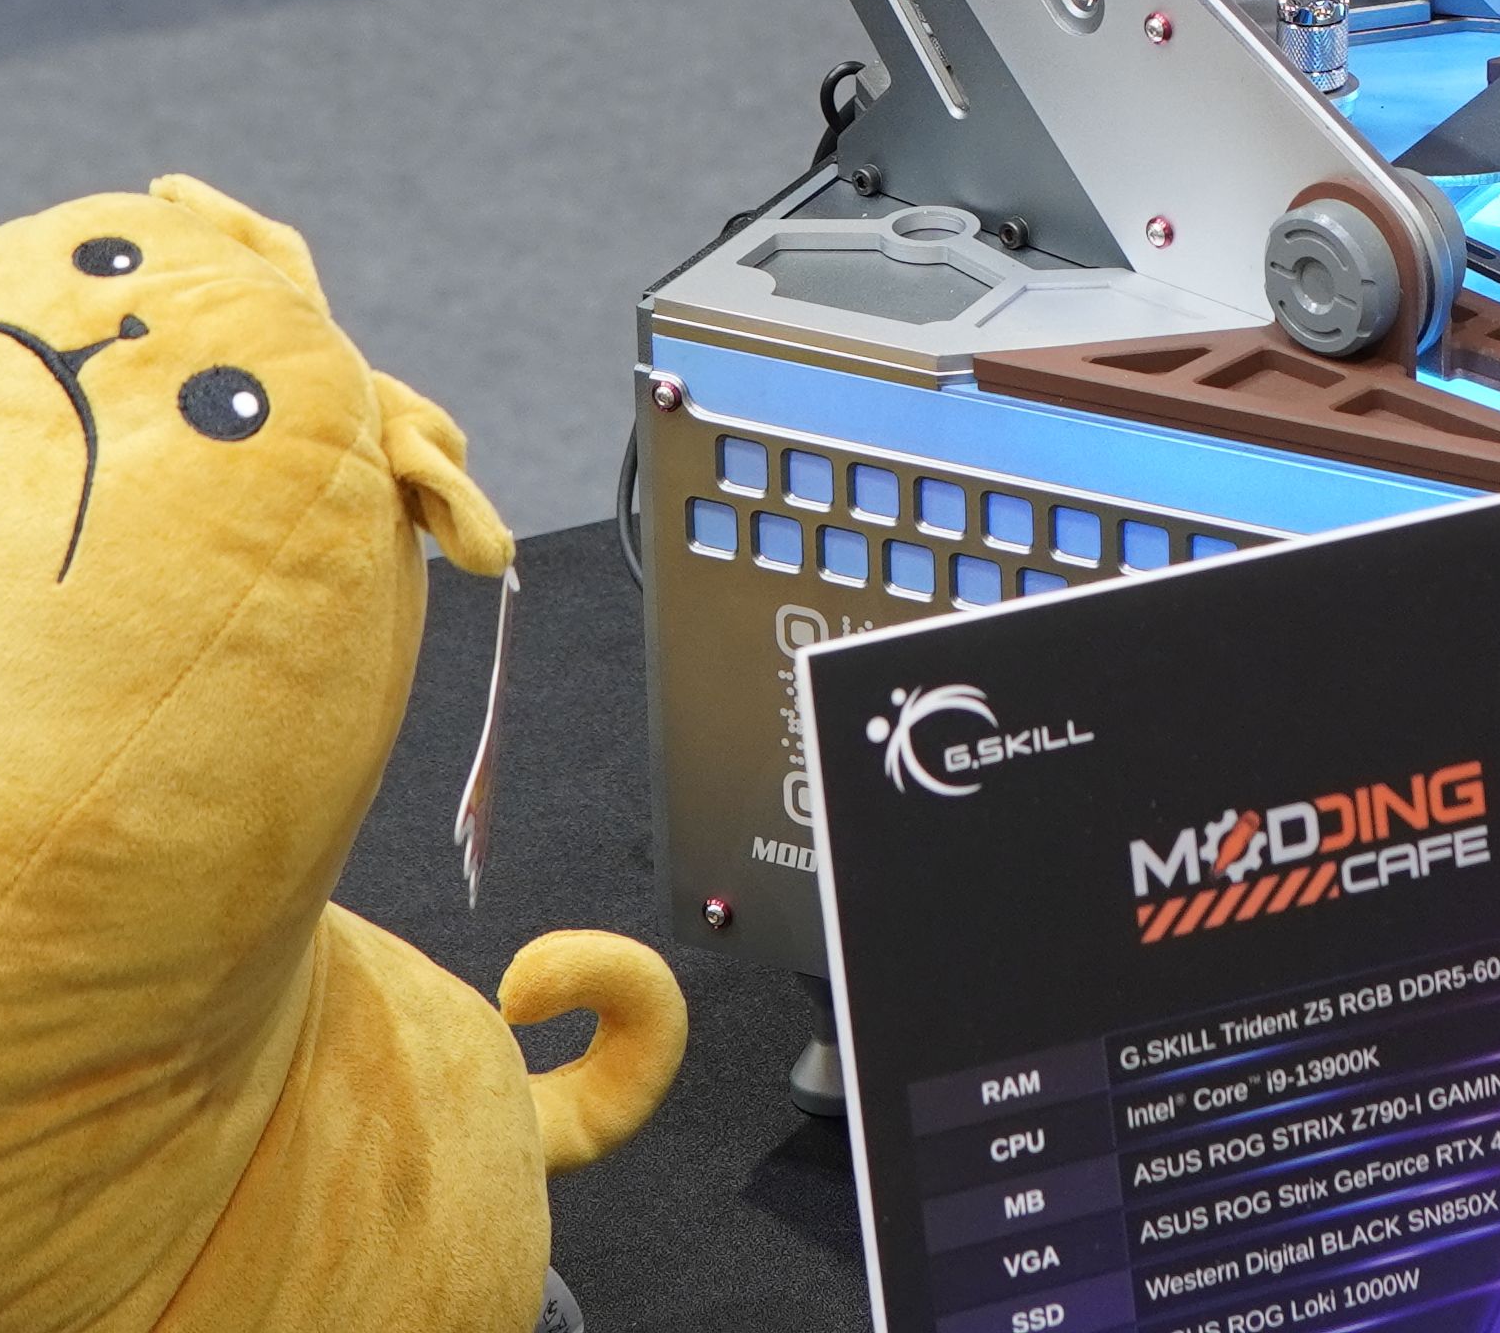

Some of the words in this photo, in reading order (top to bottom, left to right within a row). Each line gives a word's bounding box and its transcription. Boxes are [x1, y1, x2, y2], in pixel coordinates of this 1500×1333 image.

[944, 721, 1094, 774] G.SKILL
[752, 836, 818, 873] MOD
[1131, 759, 1487, 897] MODDING
[1341, 824, 1491, 894] CAFE
[1120, 1030, 1216, 1072] G.SKILL
[1219, 1008, 1298, 1048] Trident
[1304, 1001, 1333, 1026] Z5
[1340, 986, 1392, 1018] RGB
[982, 1070, 1040, 1105] RAM
[1266, 1045, 1380, 1095] i9-13900K
[991, 1129, 1045, 1163] CPU
[1134, 1150, 1202, 1187] ASUS
[1210, 1136, 1266, 1168] ROG
[1273, 1112, 1345, 1152] STRIX
[1351, 1096, 1421, 1130] Z790-I
[1005, 1190, 1045, 1219] MB
[1141, 1208, 1209, 1245] ASUS
[1216, 1193, 1272, 1225] ROG
[1279, 1174, 1328, 1209] Strix
[1335, 1152, 1429, 1193] GeForce
[1436, 1132, 1484, 1166] RTX
[1005, 1247, 1060, 1277] VGA
[1145, 1260, 1240, 1301] Western
[1246, 1237, 1314, 1277] Digital
[1322, 1215, 1402, 1256] BLACK
[1408, 1192, 1498, 1232] SN850X
[1012, 1303, 1064, 1333] SSD
[1229, 1305, 1284, 1333] ROG
[1292, 1290, 1337, 1320] Loki
[1344, 1268, 1420, 1309] 1000W
